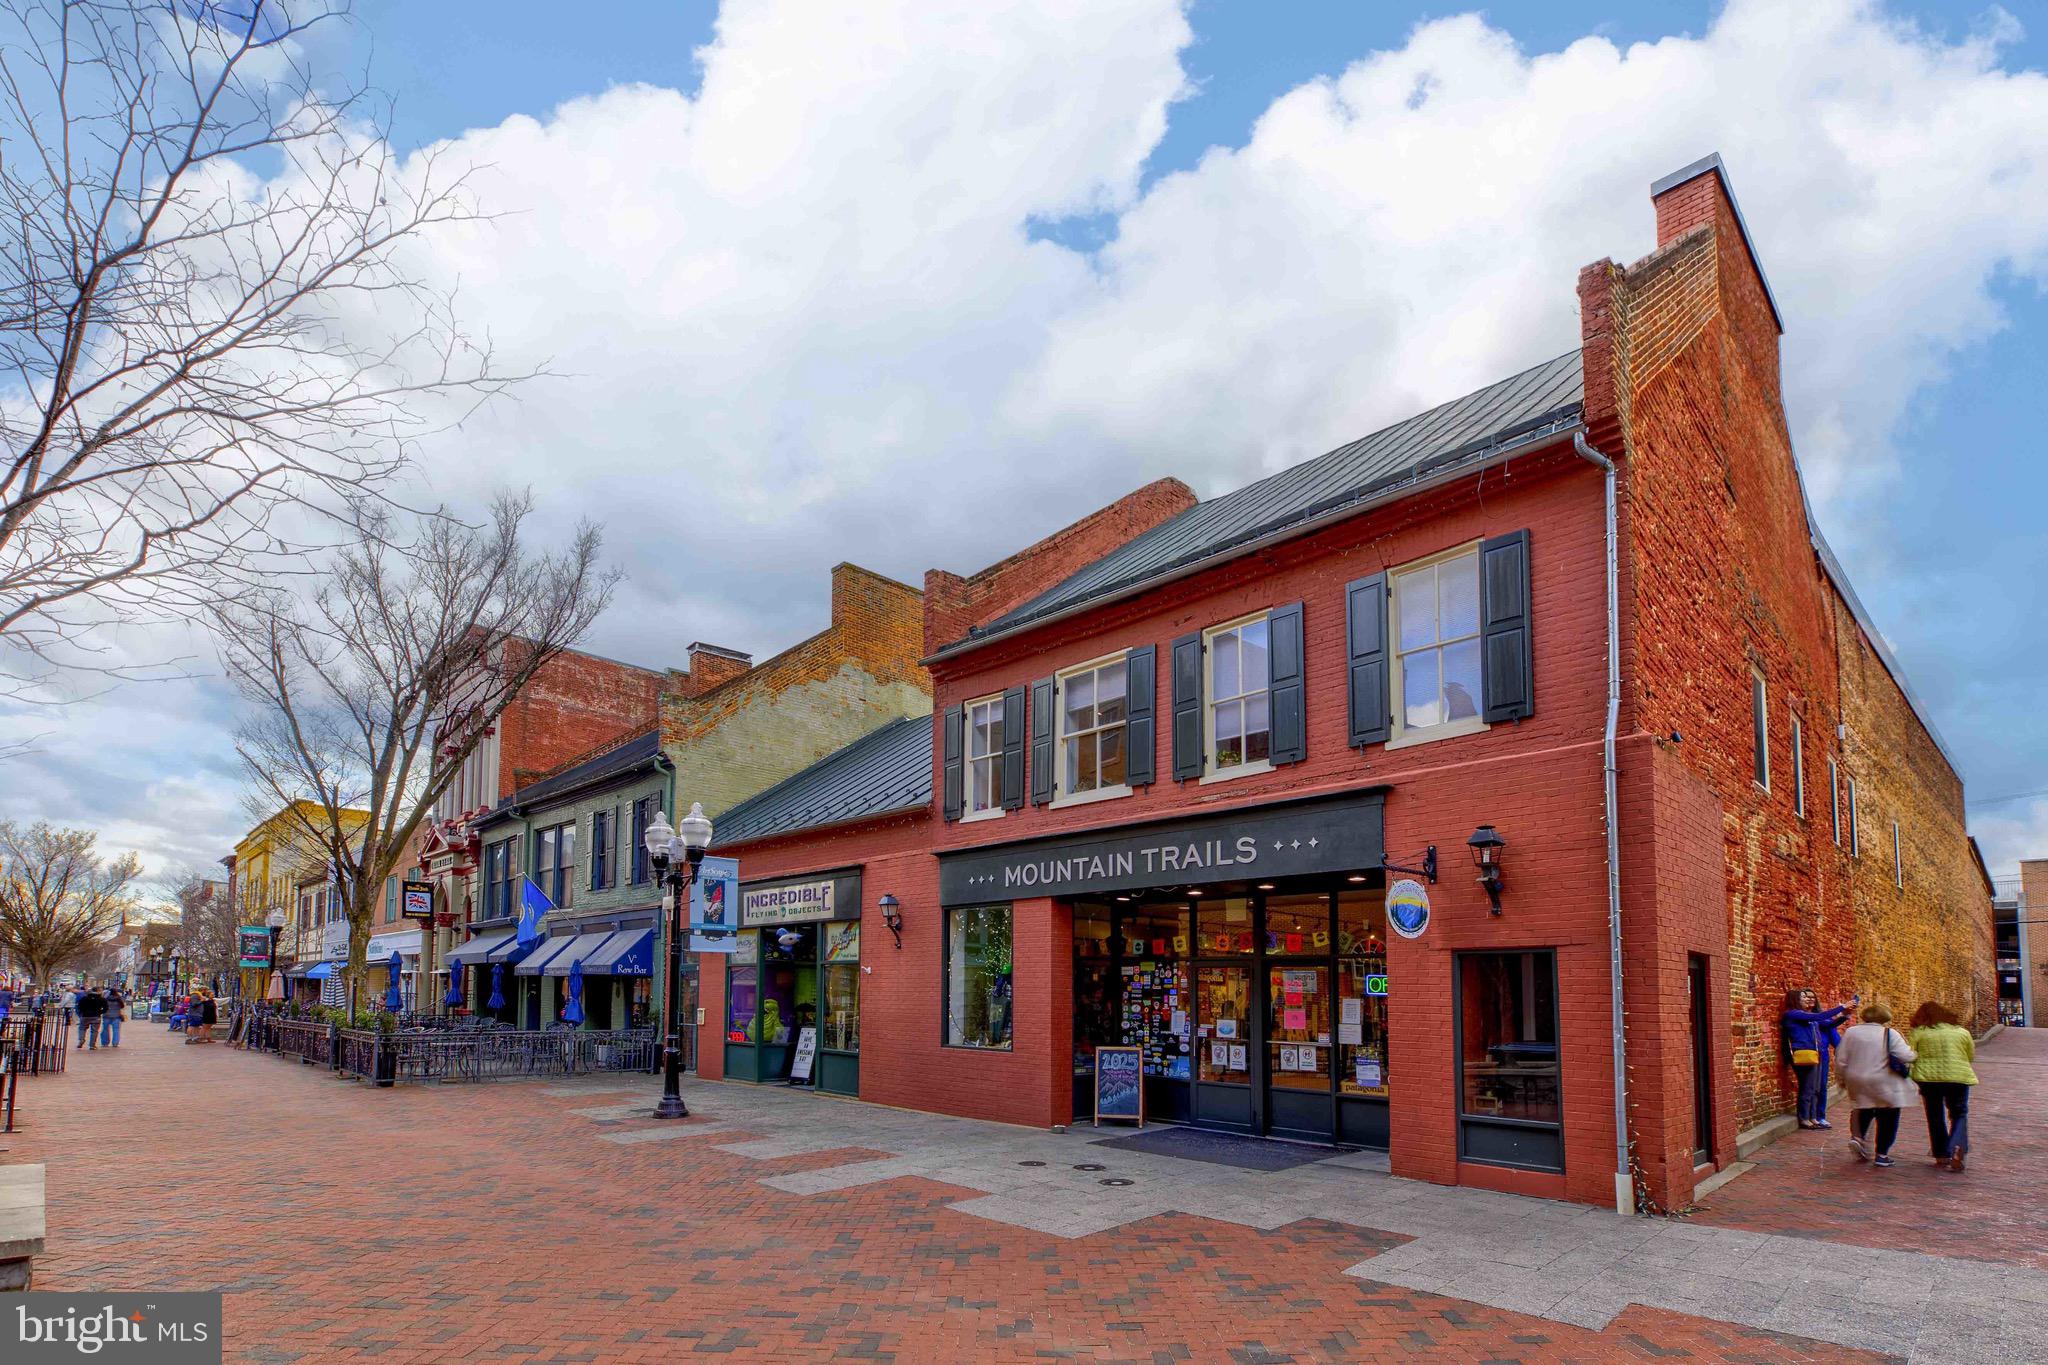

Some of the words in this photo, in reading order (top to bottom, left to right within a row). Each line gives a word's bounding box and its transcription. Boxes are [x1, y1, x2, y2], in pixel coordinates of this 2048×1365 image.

[1004, 851, 1133, 888] MOUNTAIN
[1141, 837, 1258, 873] TRAILS
[746, 885, 831, 918] INCREDIBLE
[751, 909, 778, 919] FLYING
[788, 905, 822, 915] OBJECTS
[634, 964, 647, 974] Bar
[1102, 1053, 1139, 1070] 2025
